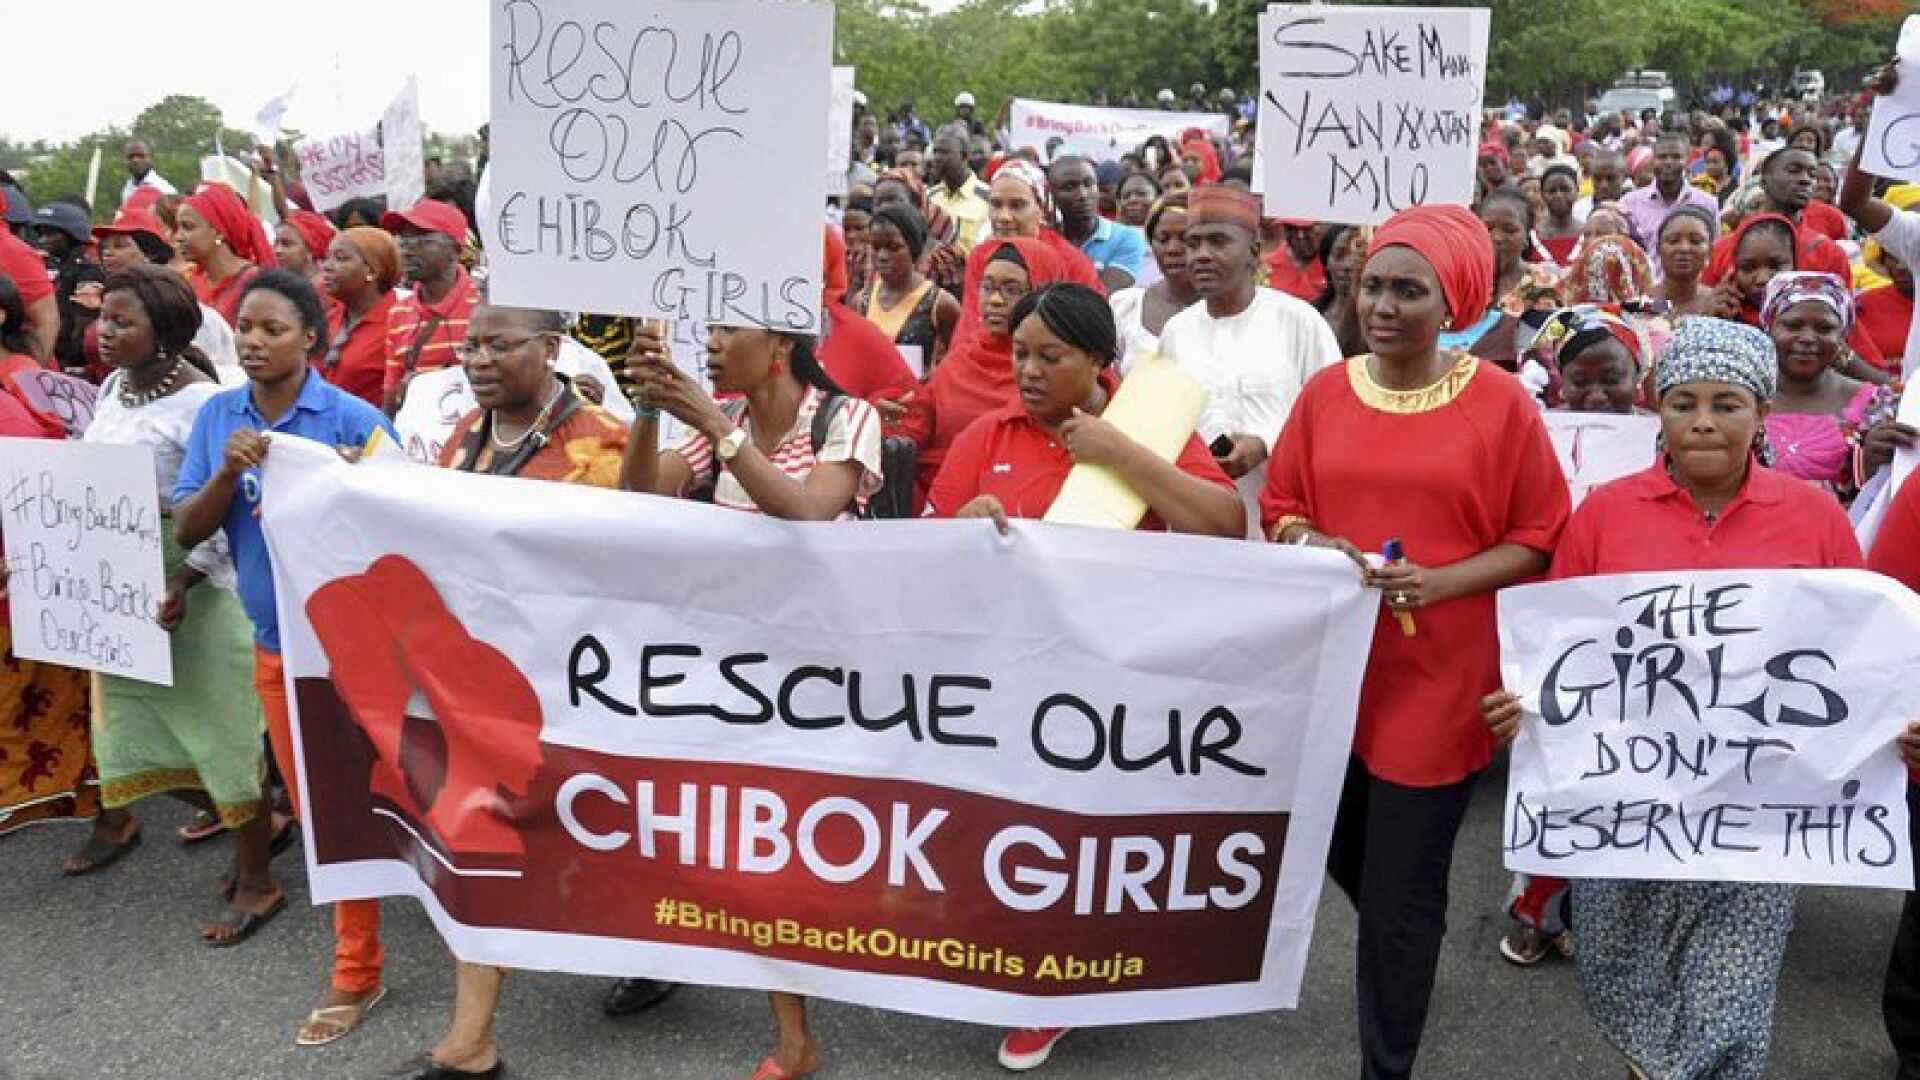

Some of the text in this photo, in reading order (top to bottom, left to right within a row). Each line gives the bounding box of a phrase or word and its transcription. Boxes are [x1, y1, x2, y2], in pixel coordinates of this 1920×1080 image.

[1265, 90, 1384, 155] YAN
[652, 268, 818, 330] GIRLS
[1618, 583, 1762, 639] THE
[567, 635, 1267, 777] RESCUE OUR
[1579, 731, 1796, 783] DON'T
[555, 773, 1266, 917] CHIBOK GIRLS
[1504, 791, 1760, 864] DESERVE
[653, 898, 1146, 984] #BringBackOurGirls Abuja
